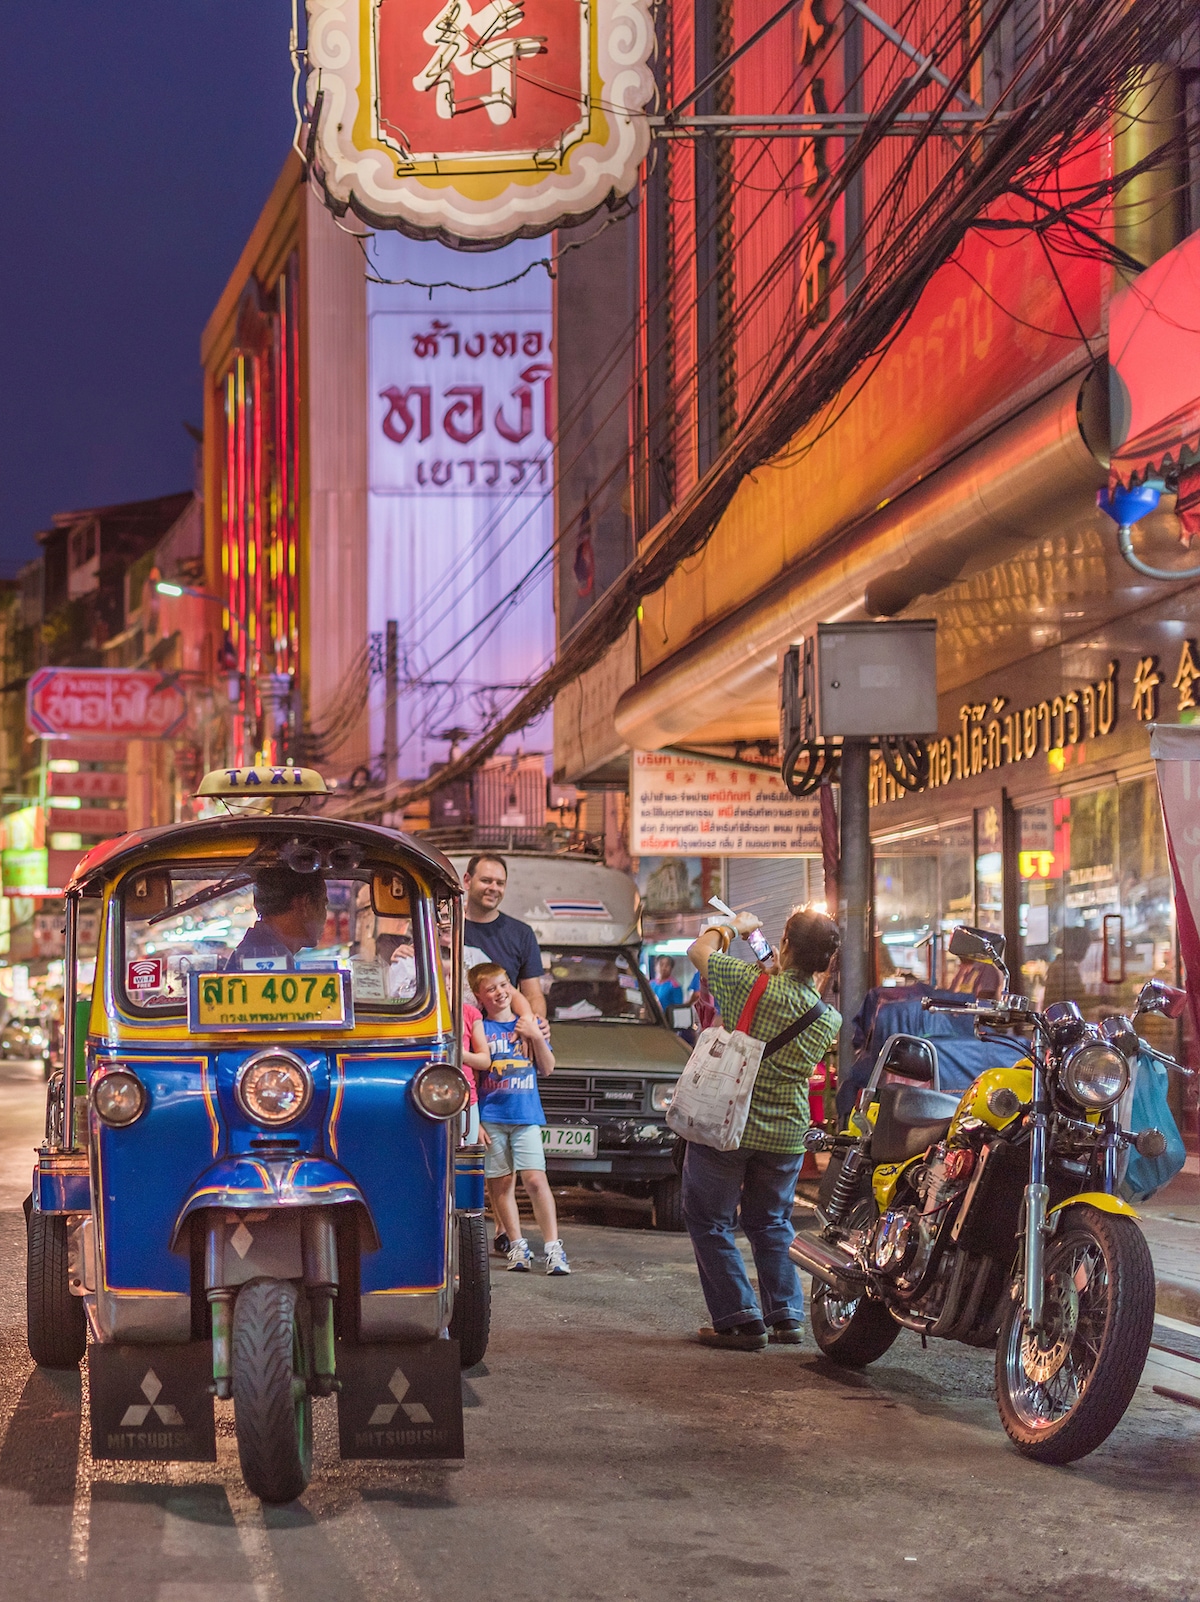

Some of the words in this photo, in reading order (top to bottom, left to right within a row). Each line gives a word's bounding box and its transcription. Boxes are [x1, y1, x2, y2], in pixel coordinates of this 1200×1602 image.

[412, 318, 553, 359] ห้างทอ
[415, 457, 548, 487] เยาวรา
[224, 767, 304, 787] TAXI
[134, 975, 155, 983] Wi-Fi
[203, 976, 248, 1005] สก
[261, 977, 339, 1004] 4074
[604, 1091, 634, 1100] NISSAN
[557, 1130, 592, 1145] 7204
